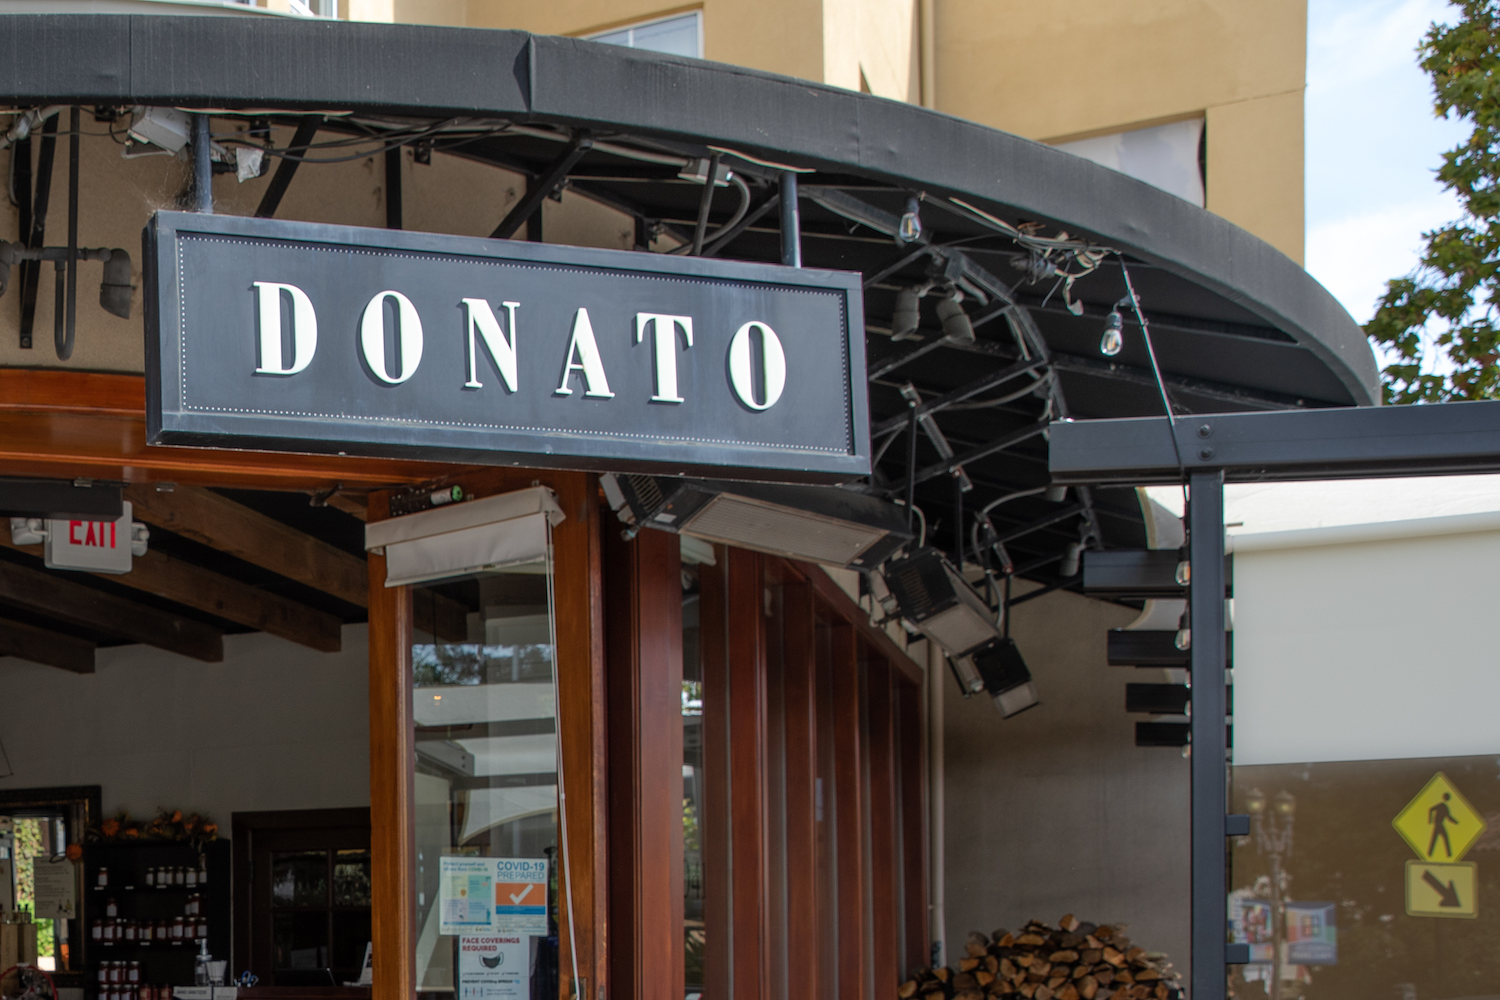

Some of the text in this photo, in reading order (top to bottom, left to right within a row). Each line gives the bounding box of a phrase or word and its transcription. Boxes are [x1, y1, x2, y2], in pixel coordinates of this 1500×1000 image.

[252, 280, 787, 412] DONATO
[496, 861, 545, 871] COVID-19
[497, 871, 545, 880] PREPARED
